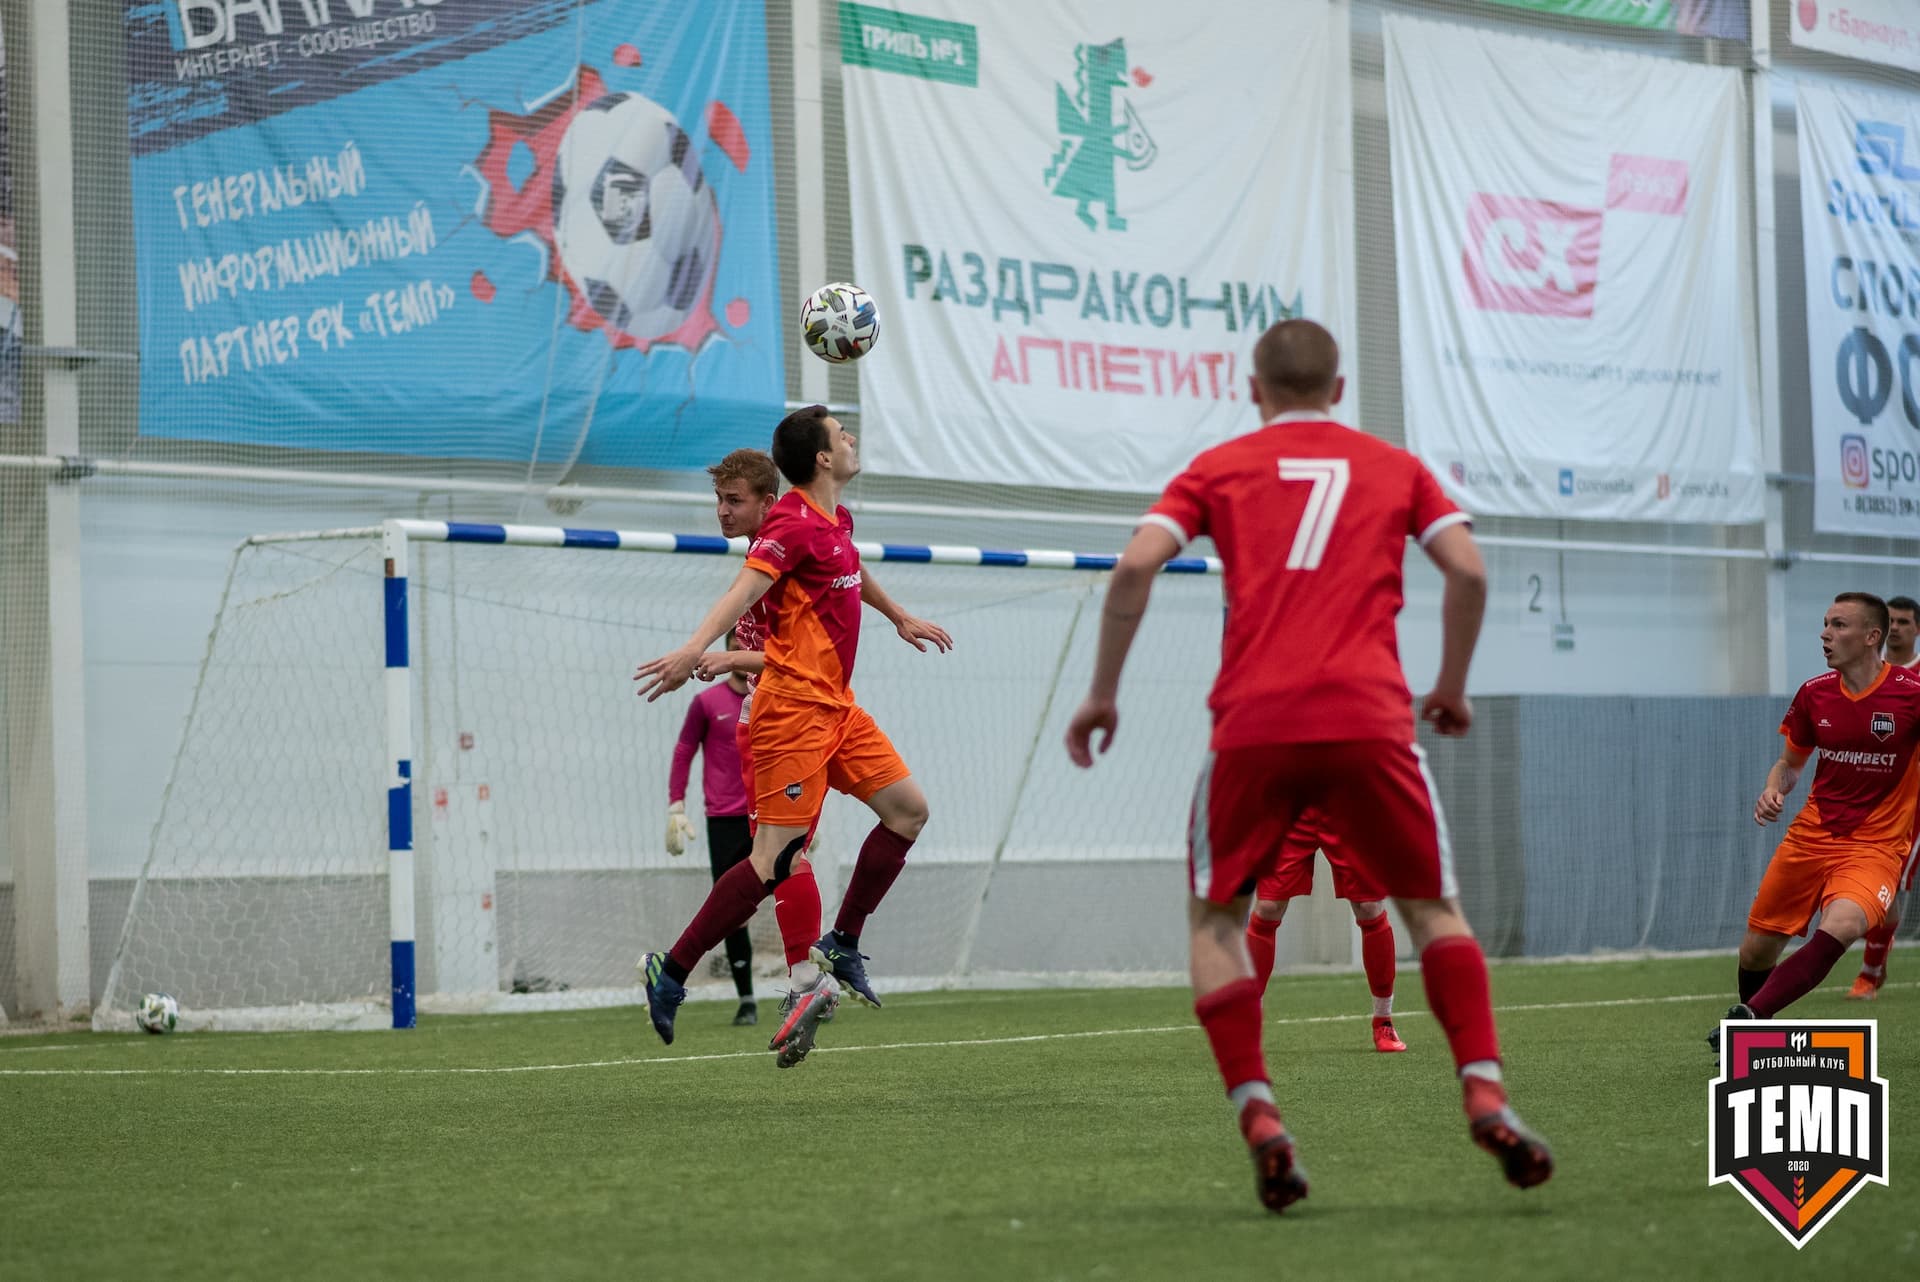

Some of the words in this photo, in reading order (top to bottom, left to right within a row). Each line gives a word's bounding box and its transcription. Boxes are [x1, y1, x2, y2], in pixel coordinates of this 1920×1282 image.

[175, 40, 280, 80] ИНТЕРНЕТ
[299, 10, 436, 57] СООБЩЕСТВО
[173, 140, 366, 232] ГЕНЕРАЛЬНЫЙ
[179, 200, 436, 312] ИНФОРМАЦИОННЫЙ
[902, 244, 1303, 332] РАЗДРАКОНИМ
[180, 315, 299, 385] ПАРТНЕР
[307, 299, 354, 351] ФК
[360, 280, 455, 338] «ТЕМП»
[991, 333, 1239, 402] АППЕТИТ!
[1872, 449, 1920, 490] spo
[1277, 457, 1350, 571] 7
[1527, 573, 1542, 613] 2
